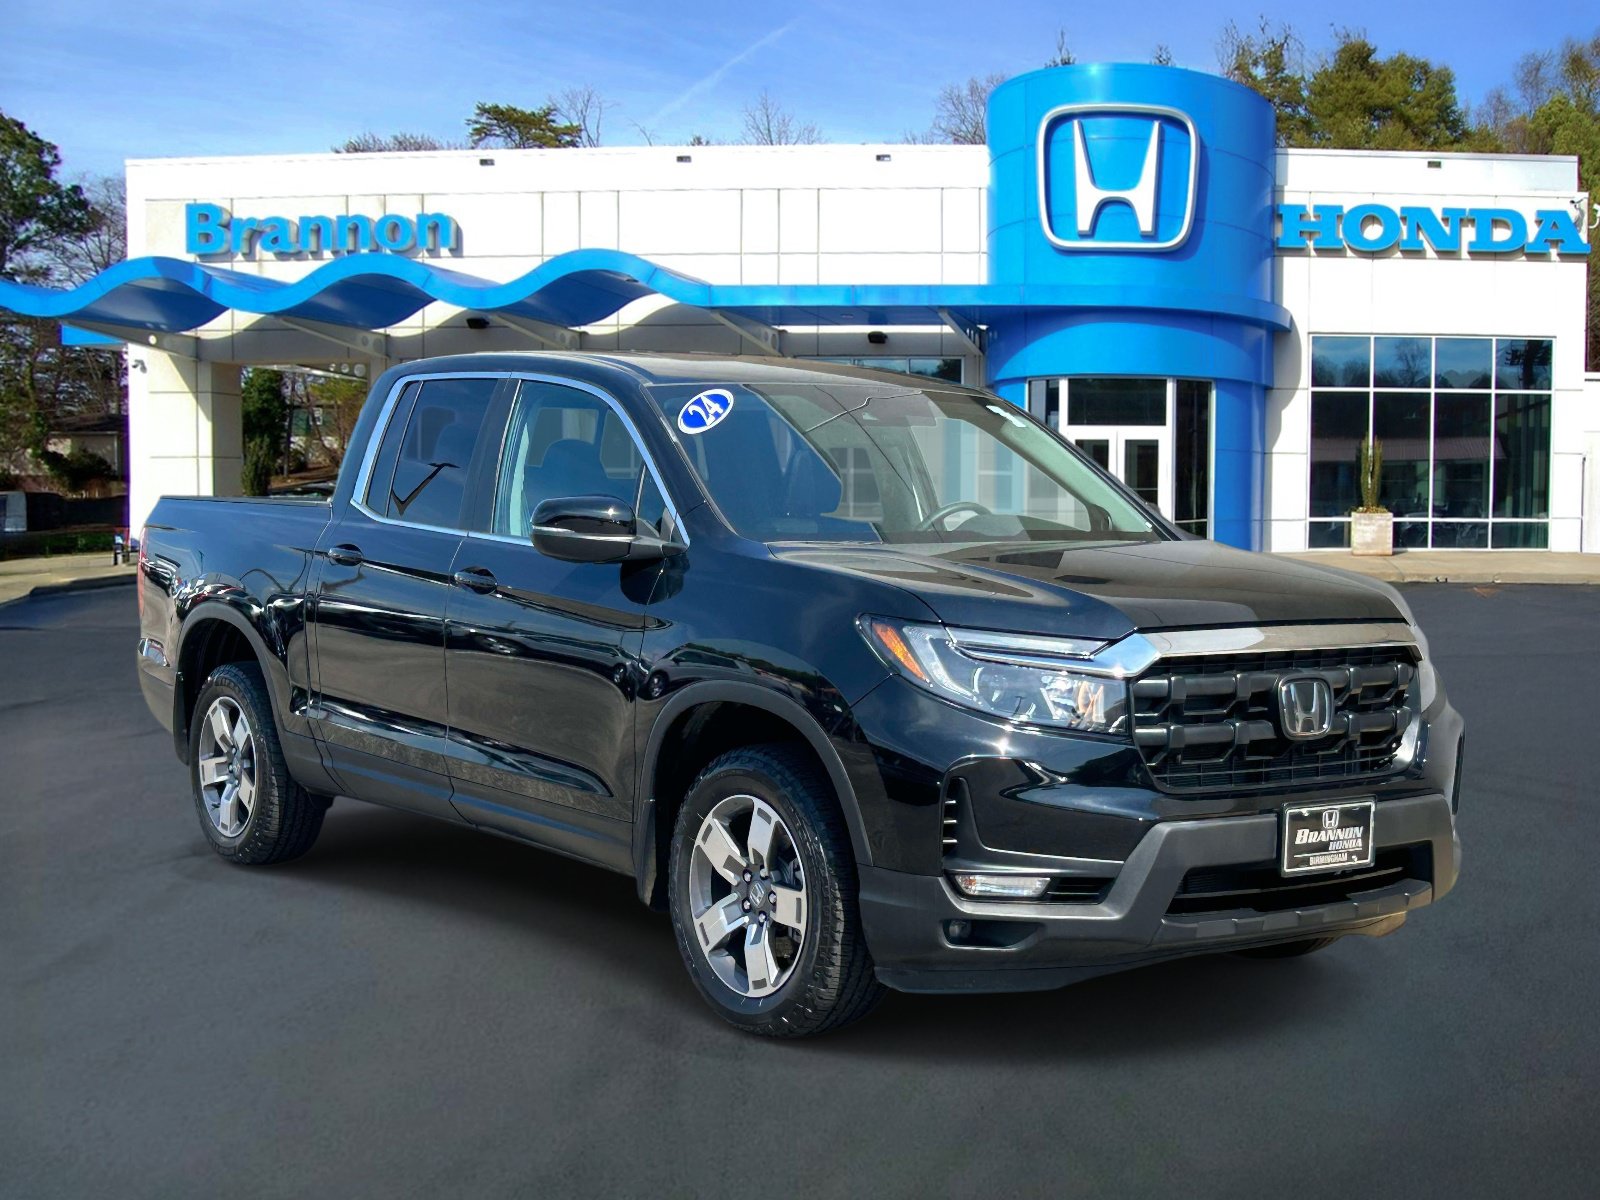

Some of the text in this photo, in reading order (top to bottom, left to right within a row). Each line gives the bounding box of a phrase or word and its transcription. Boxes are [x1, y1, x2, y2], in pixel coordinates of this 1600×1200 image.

[185, 203, 454, 256] Brannon
[1277, 203, 1591, 255] HONDA
[687, 394, 724, 427] 24
[1294, 826, 1364, 845] BRANNON
[1328, 838, 1363, 851] HONDA
[1309, 852, 1348, 866] BIRMINGHAM
